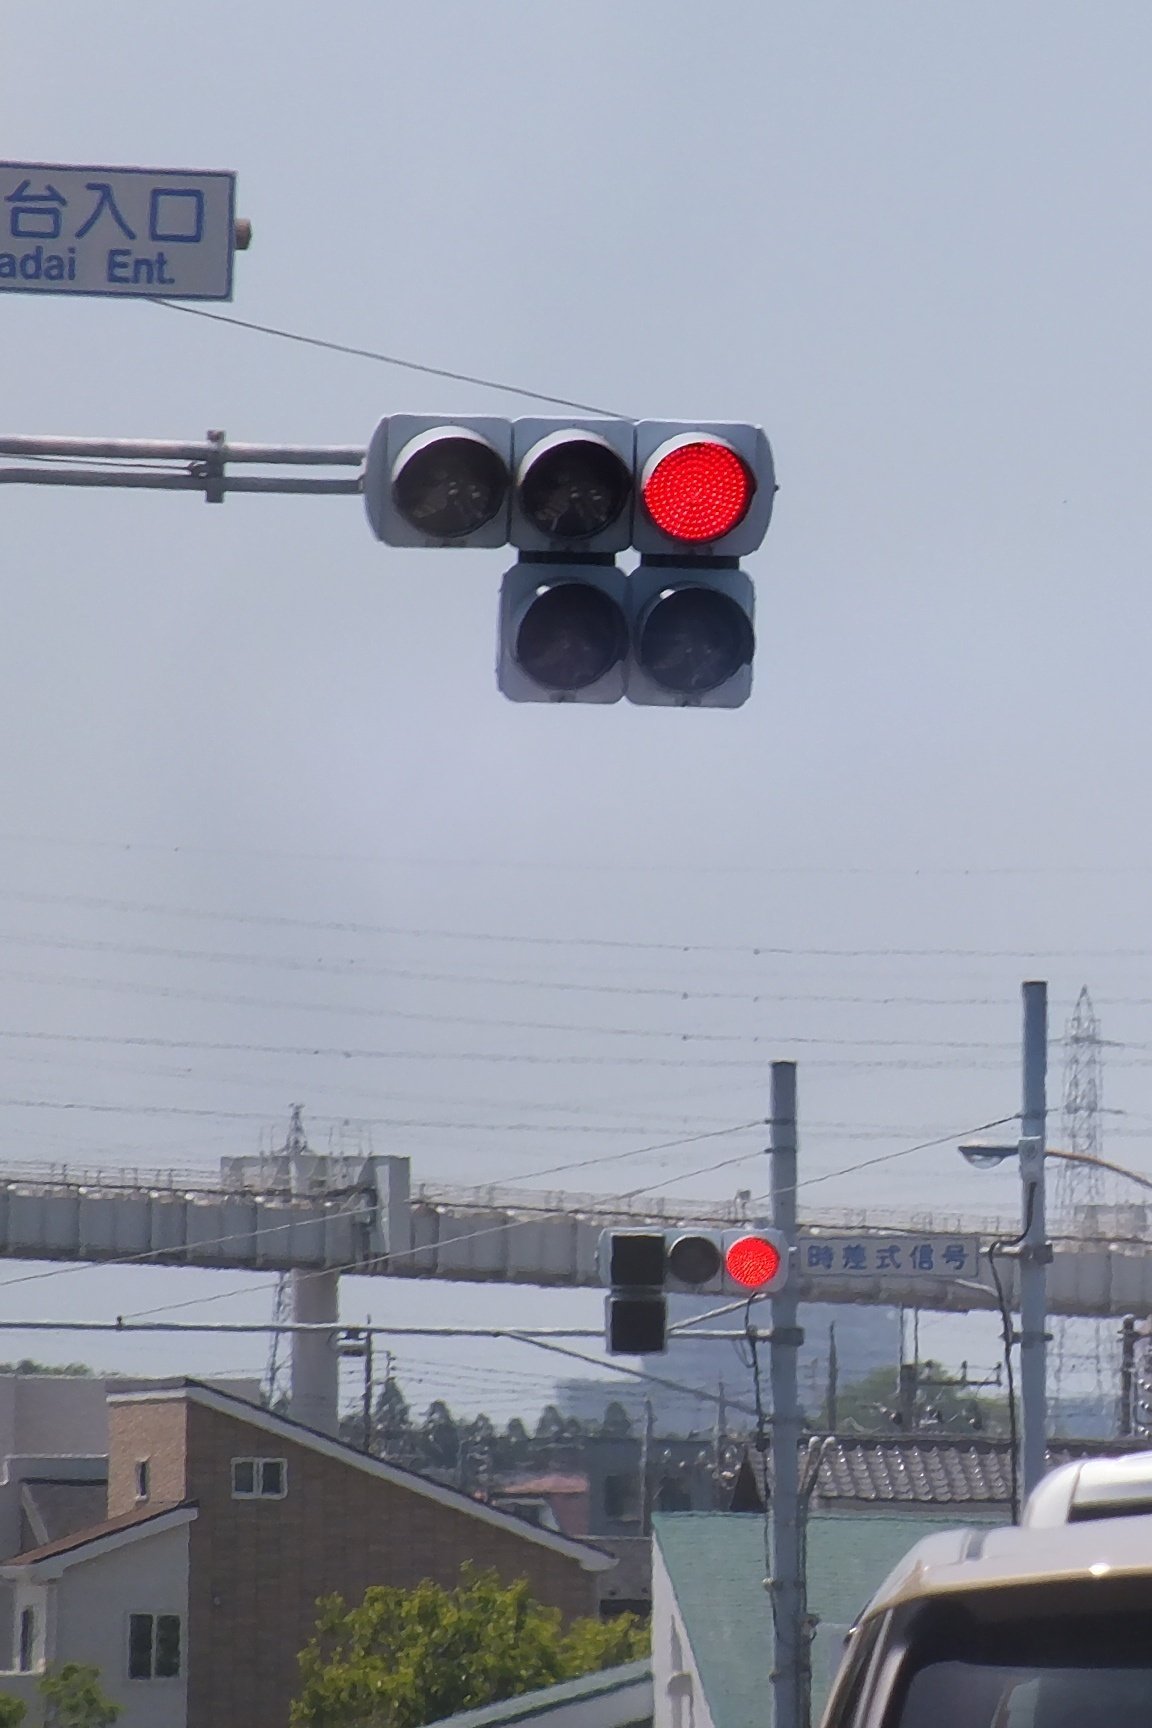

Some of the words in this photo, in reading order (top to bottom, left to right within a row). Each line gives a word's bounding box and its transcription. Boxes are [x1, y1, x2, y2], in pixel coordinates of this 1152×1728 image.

[4, 180, 204, 242] 台入口
[107, 249, 175, 284] Ent.
[807, 1243, 968, 1270] 時差式信号
